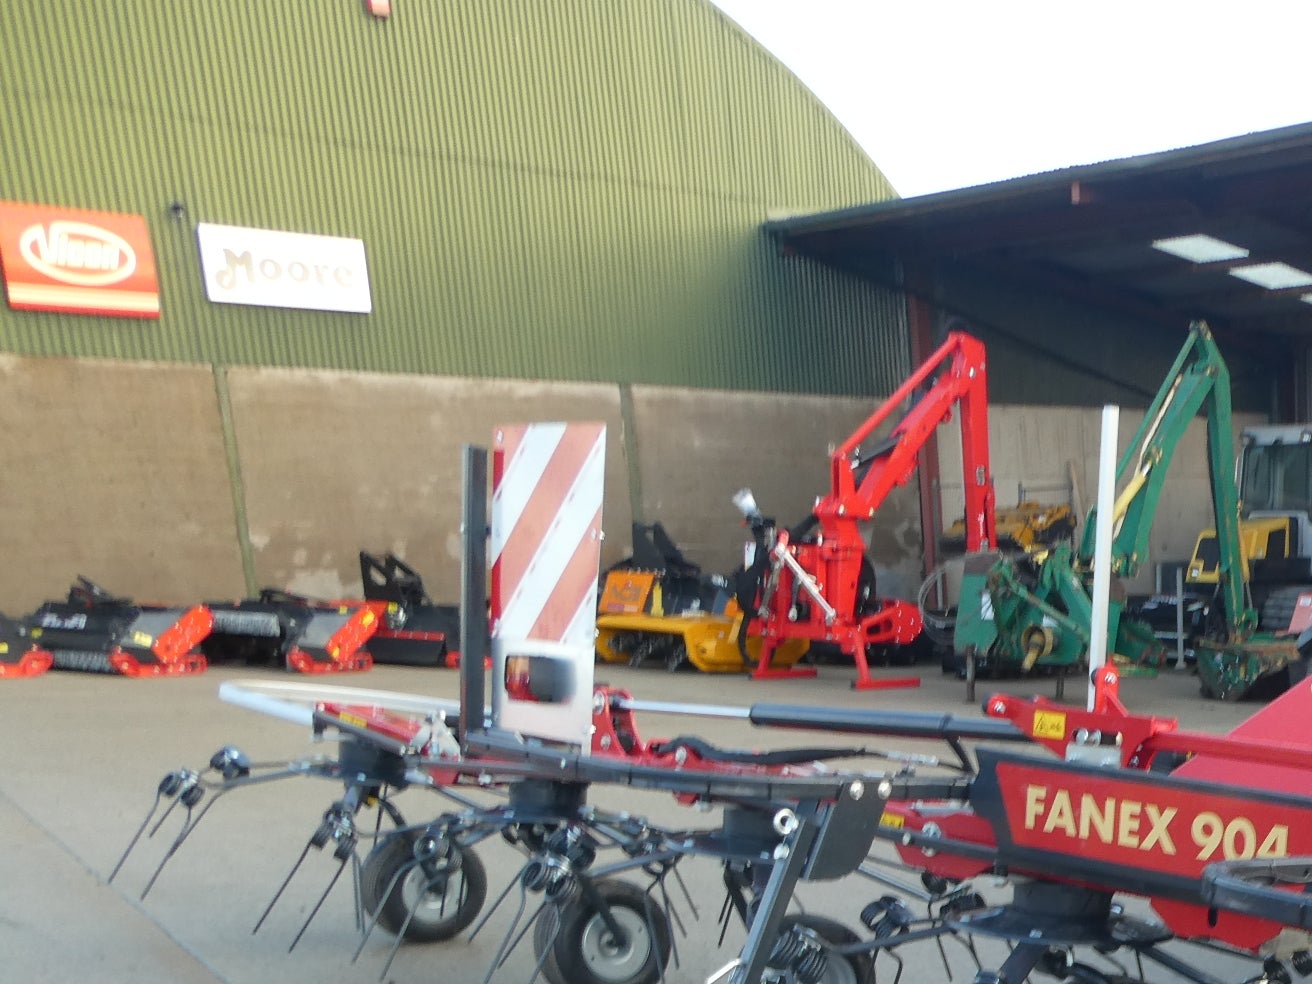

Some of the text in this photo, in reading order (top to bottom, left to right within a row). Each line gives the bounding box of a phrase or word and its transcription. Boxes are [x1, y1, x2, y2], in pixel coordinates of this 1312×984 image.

[215, 248, 353, 289] Moore
[1024, 783, 1290, 861] FANEX 904
